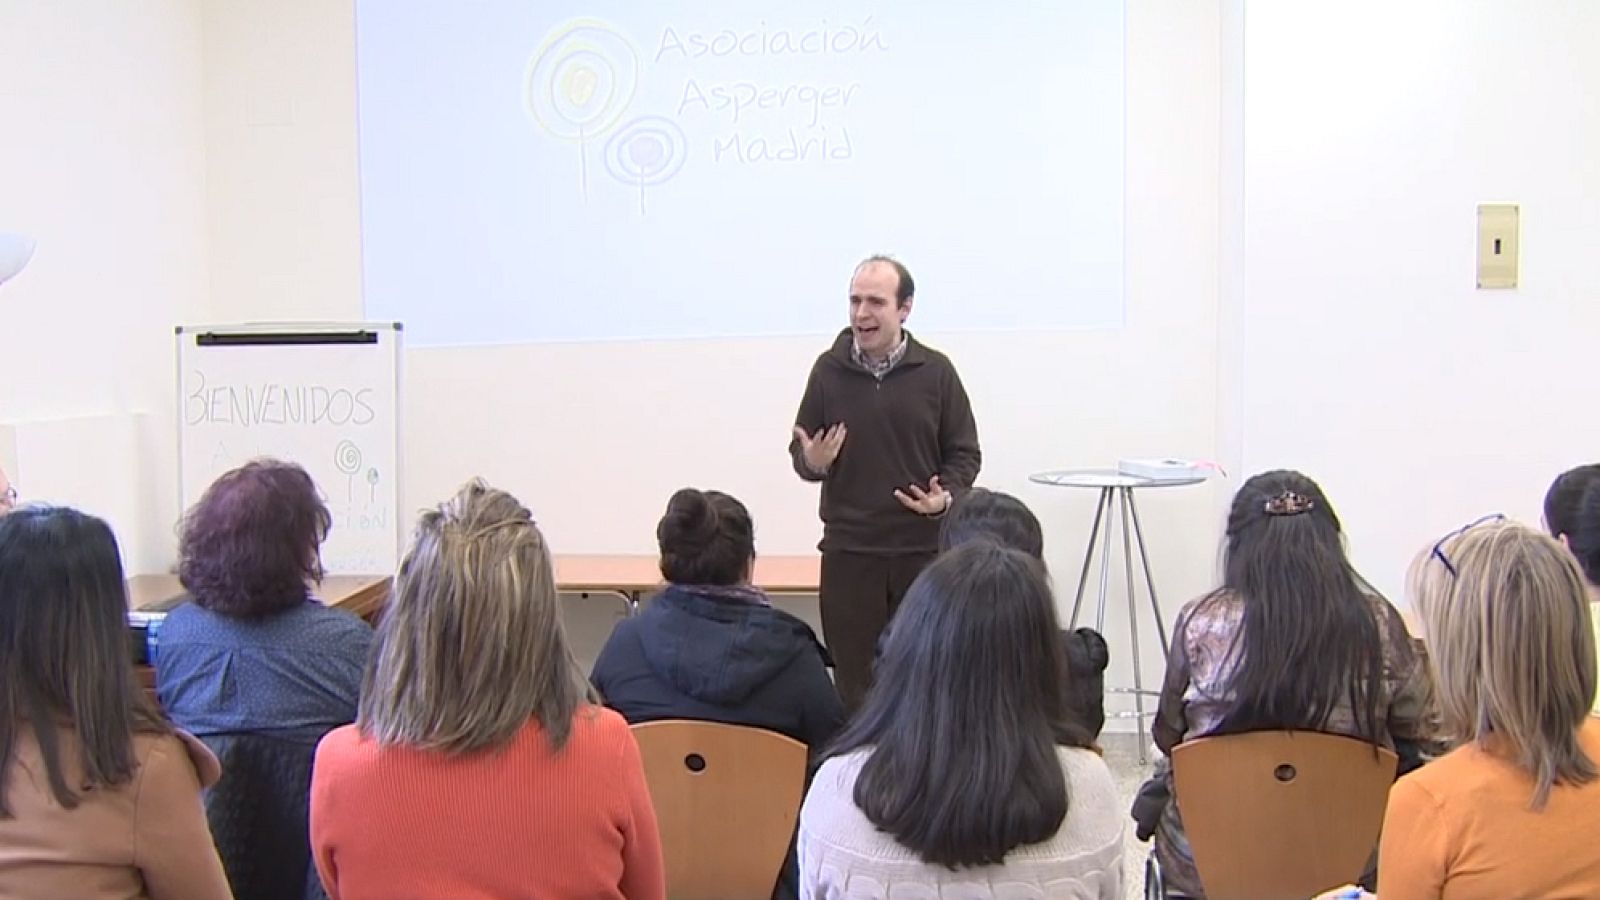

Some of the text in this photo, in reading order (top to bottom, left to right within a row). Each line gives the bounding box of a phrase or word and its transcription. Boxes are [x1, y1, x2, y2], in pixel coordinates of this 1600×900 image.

[655, 16, 889, 62] Asociación
[678, 79, 860, 127] Asperger
[713, 127, 853, 163] Madrid
[185, 369, 375, 427] BIENVENIDOS
